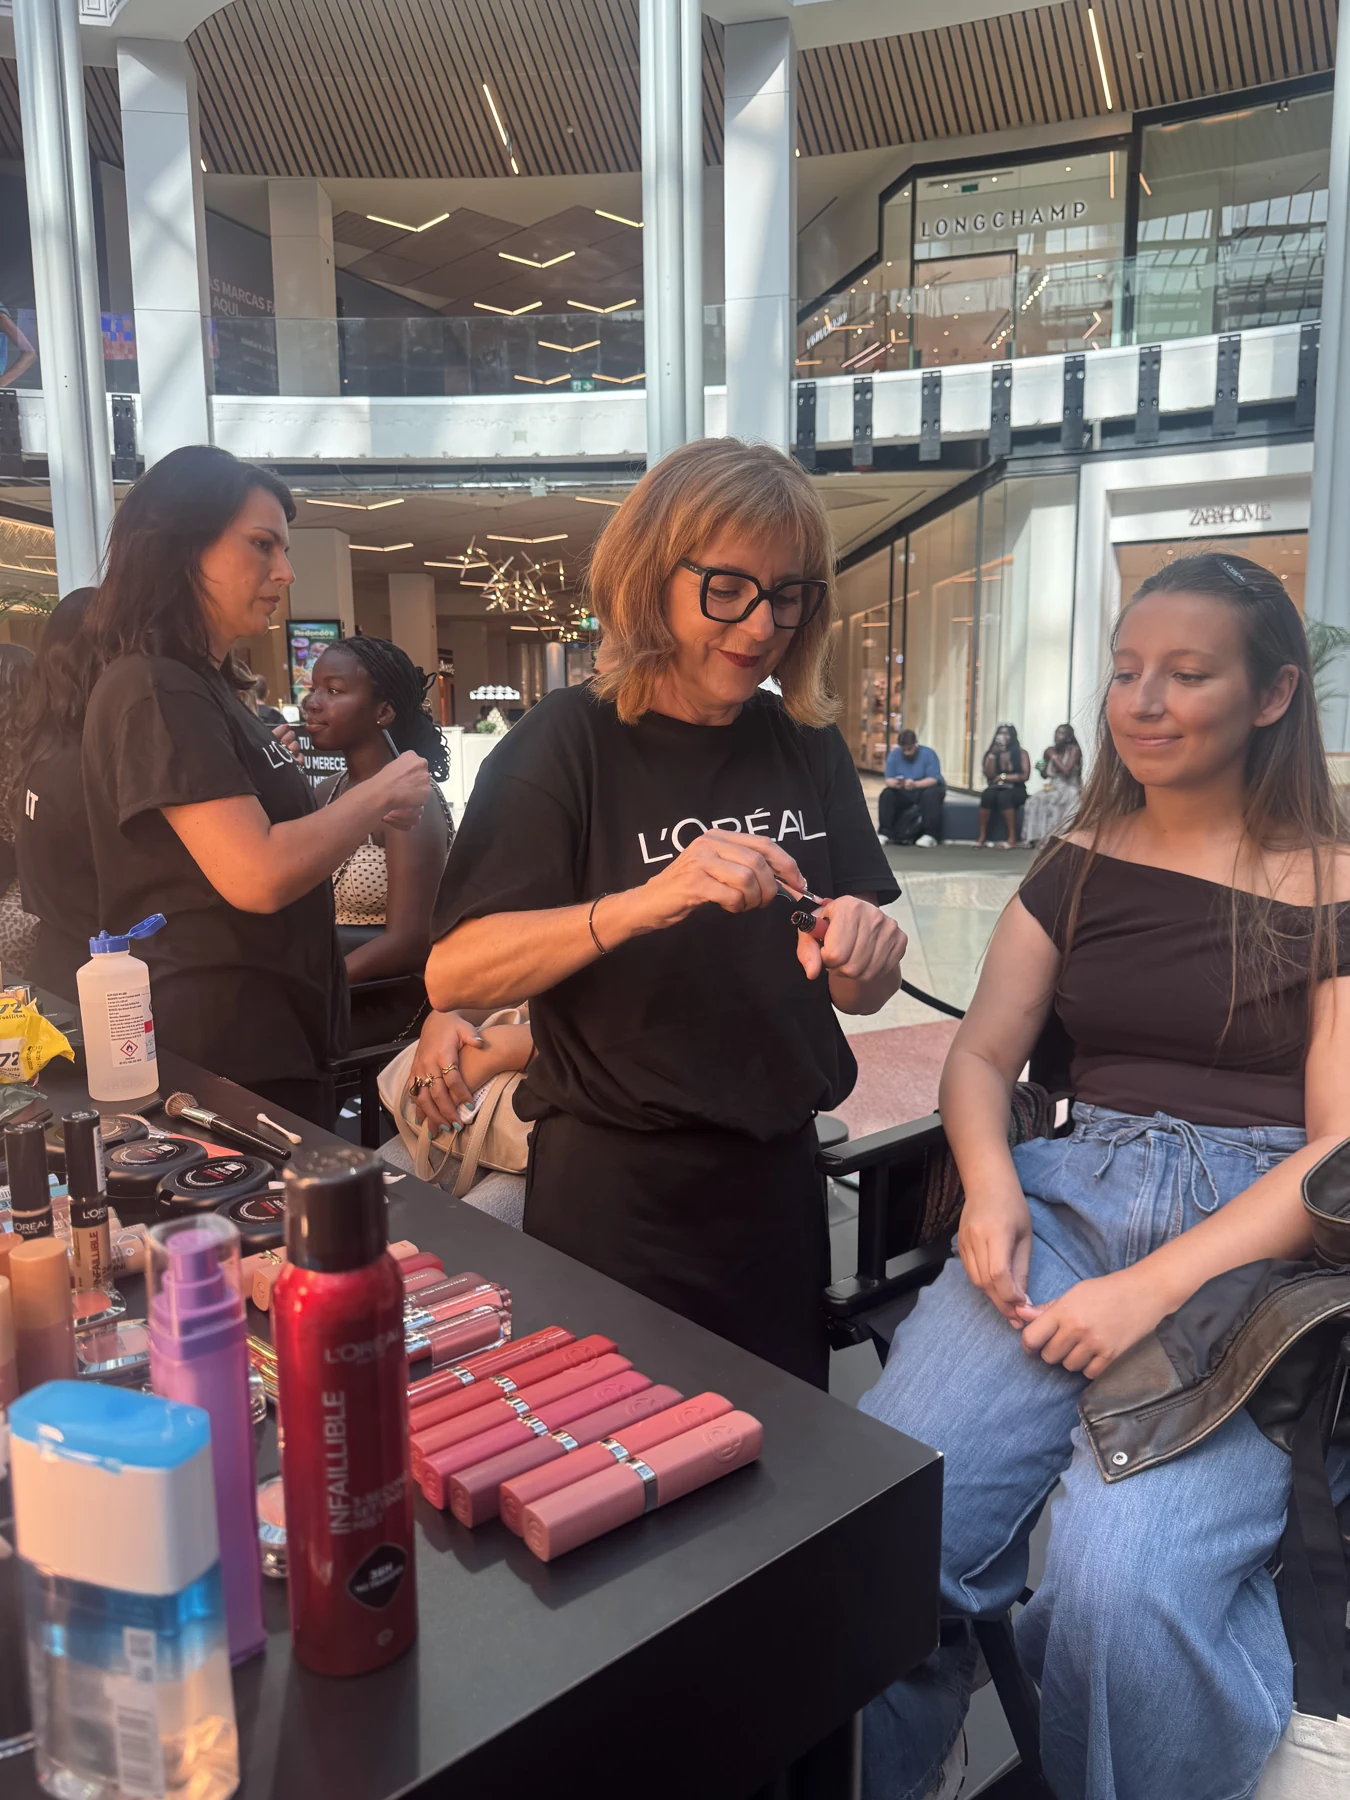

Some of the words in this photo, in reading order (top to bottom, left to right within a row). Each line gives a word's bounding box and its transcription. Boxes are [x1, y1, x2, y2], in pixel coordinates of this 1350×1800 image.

[921, 202, 1085, 237] LONGCHAMP
[221, 282, 265, 310] MARCAS
[298, 736, 310, 750] TU
[312, 756, 348, 771] MERECE
[0, 1051, 20, 1067] 72
[322, 1390, 351, 1535] INFAILLIBLE
